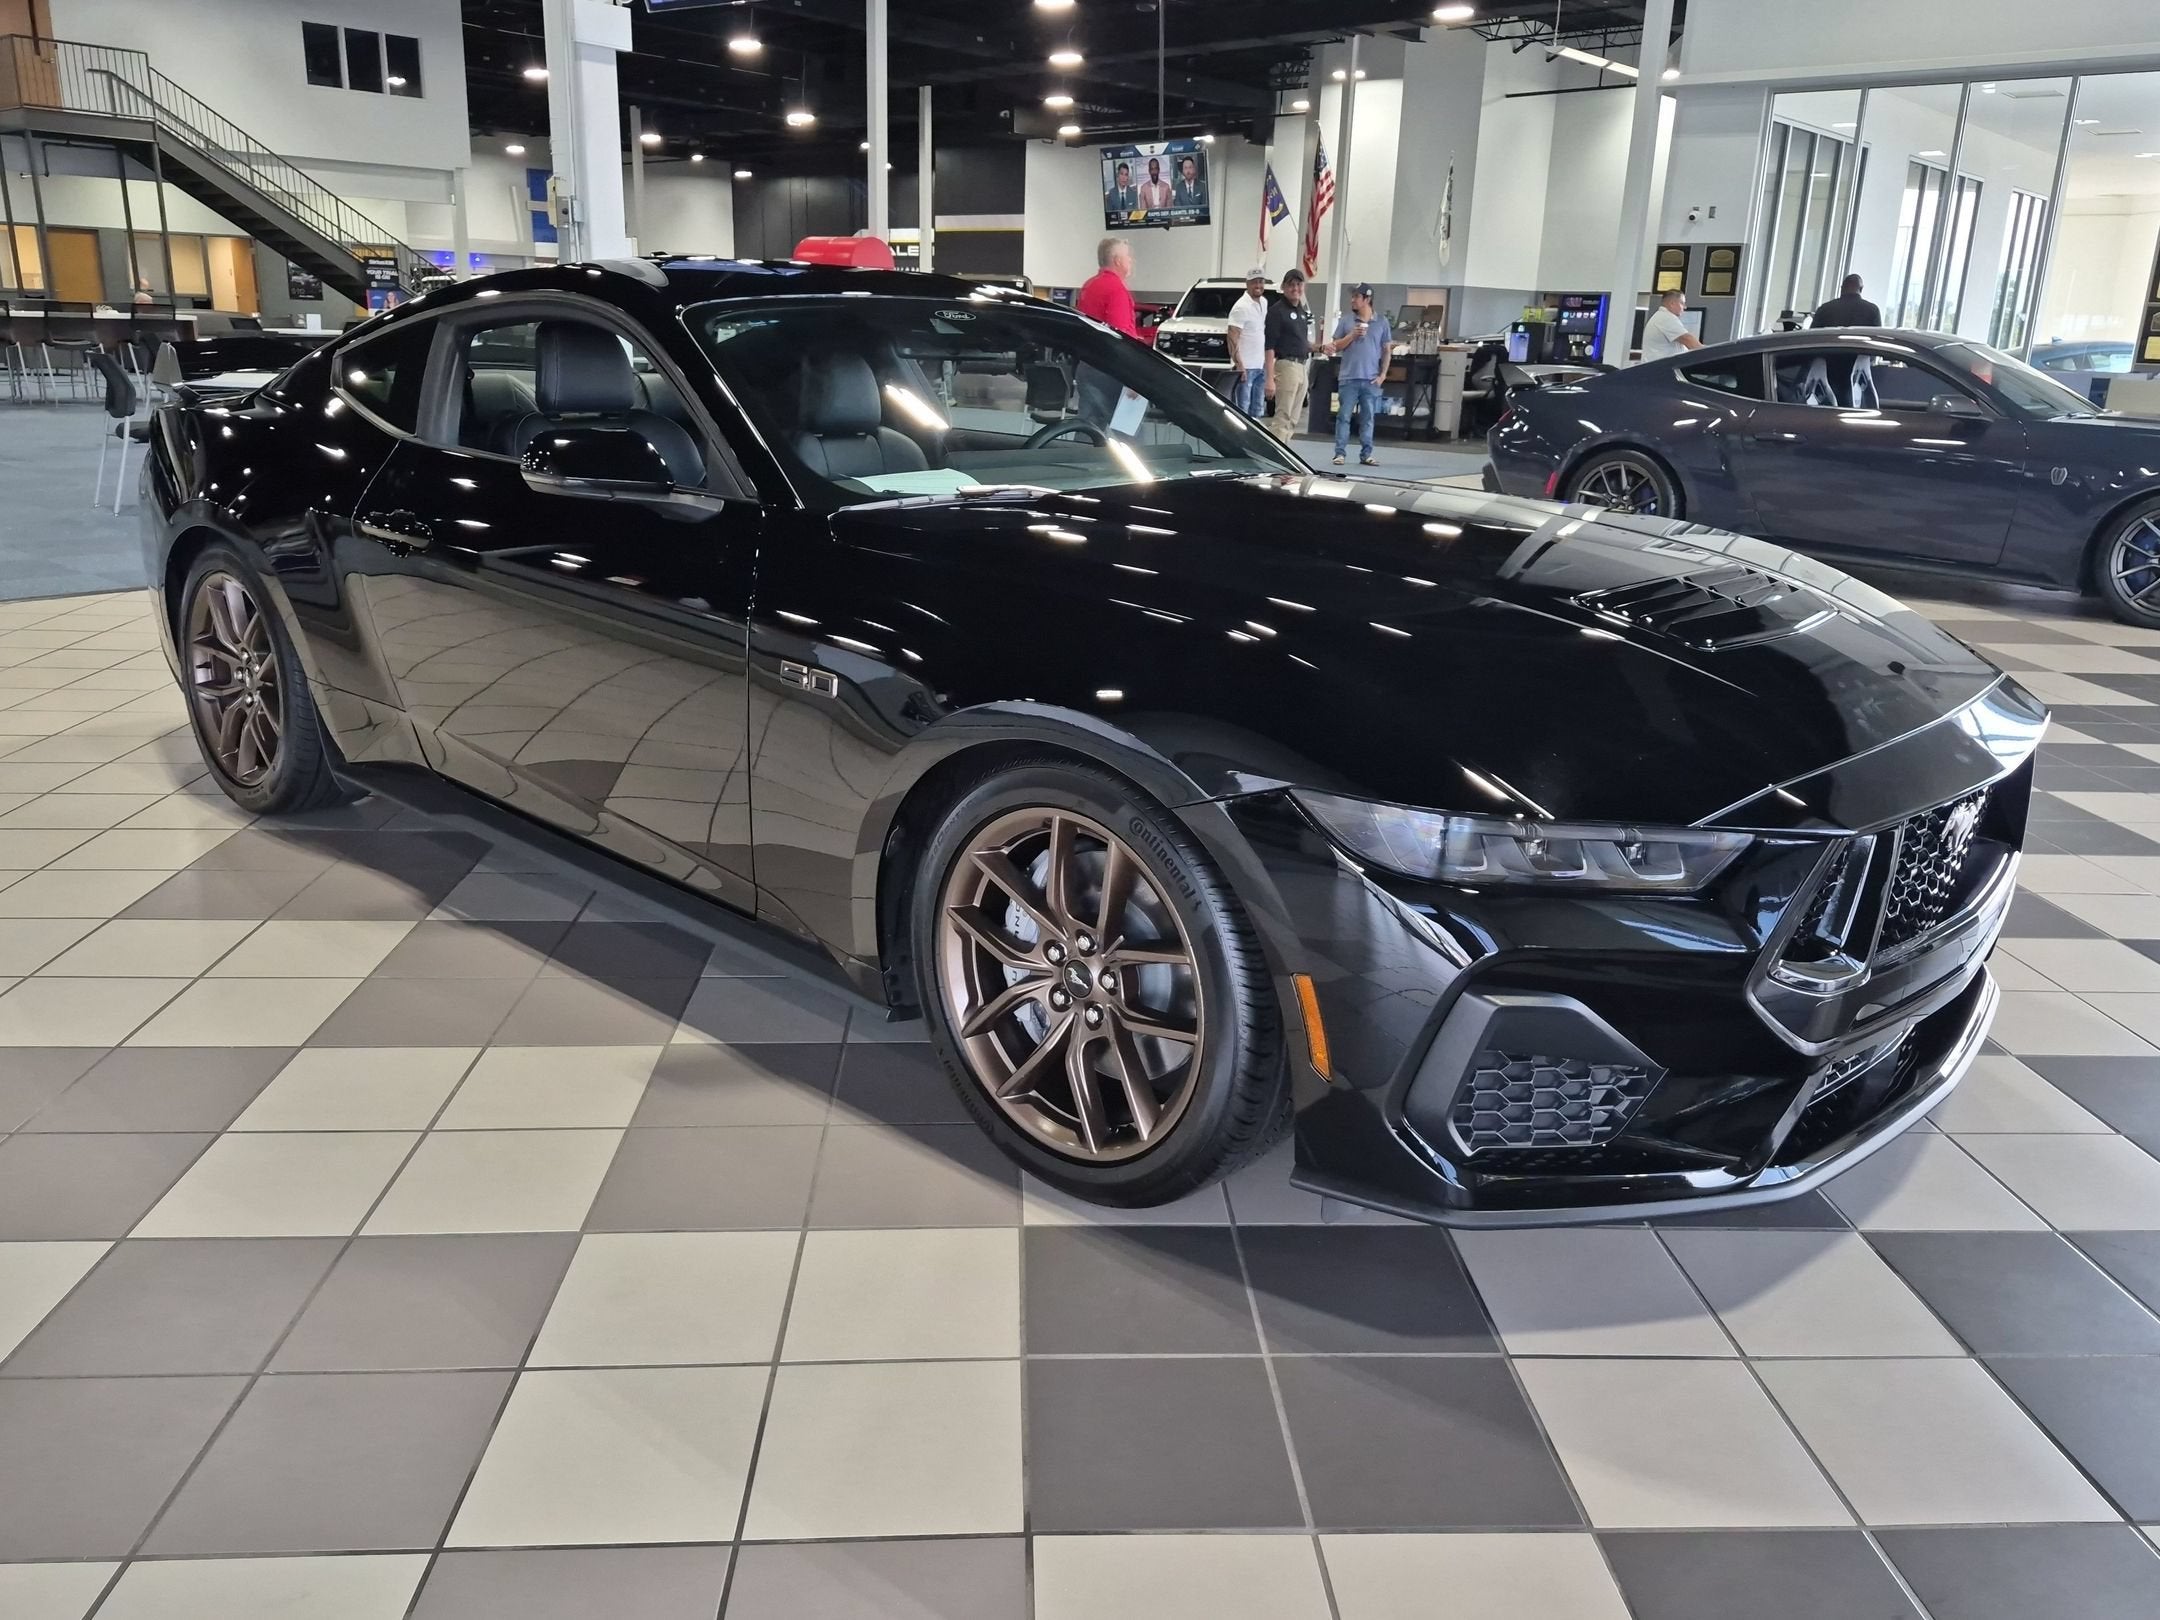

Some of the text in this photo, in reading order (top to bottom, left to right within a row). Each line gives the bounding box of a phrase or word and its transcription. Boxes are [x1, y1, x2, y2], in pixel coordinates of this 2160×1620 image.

[941, 310, 972, 320] Ford
[780, 660, 838, 699] 5.0
[1129, 816, 1196, 899] Continental
